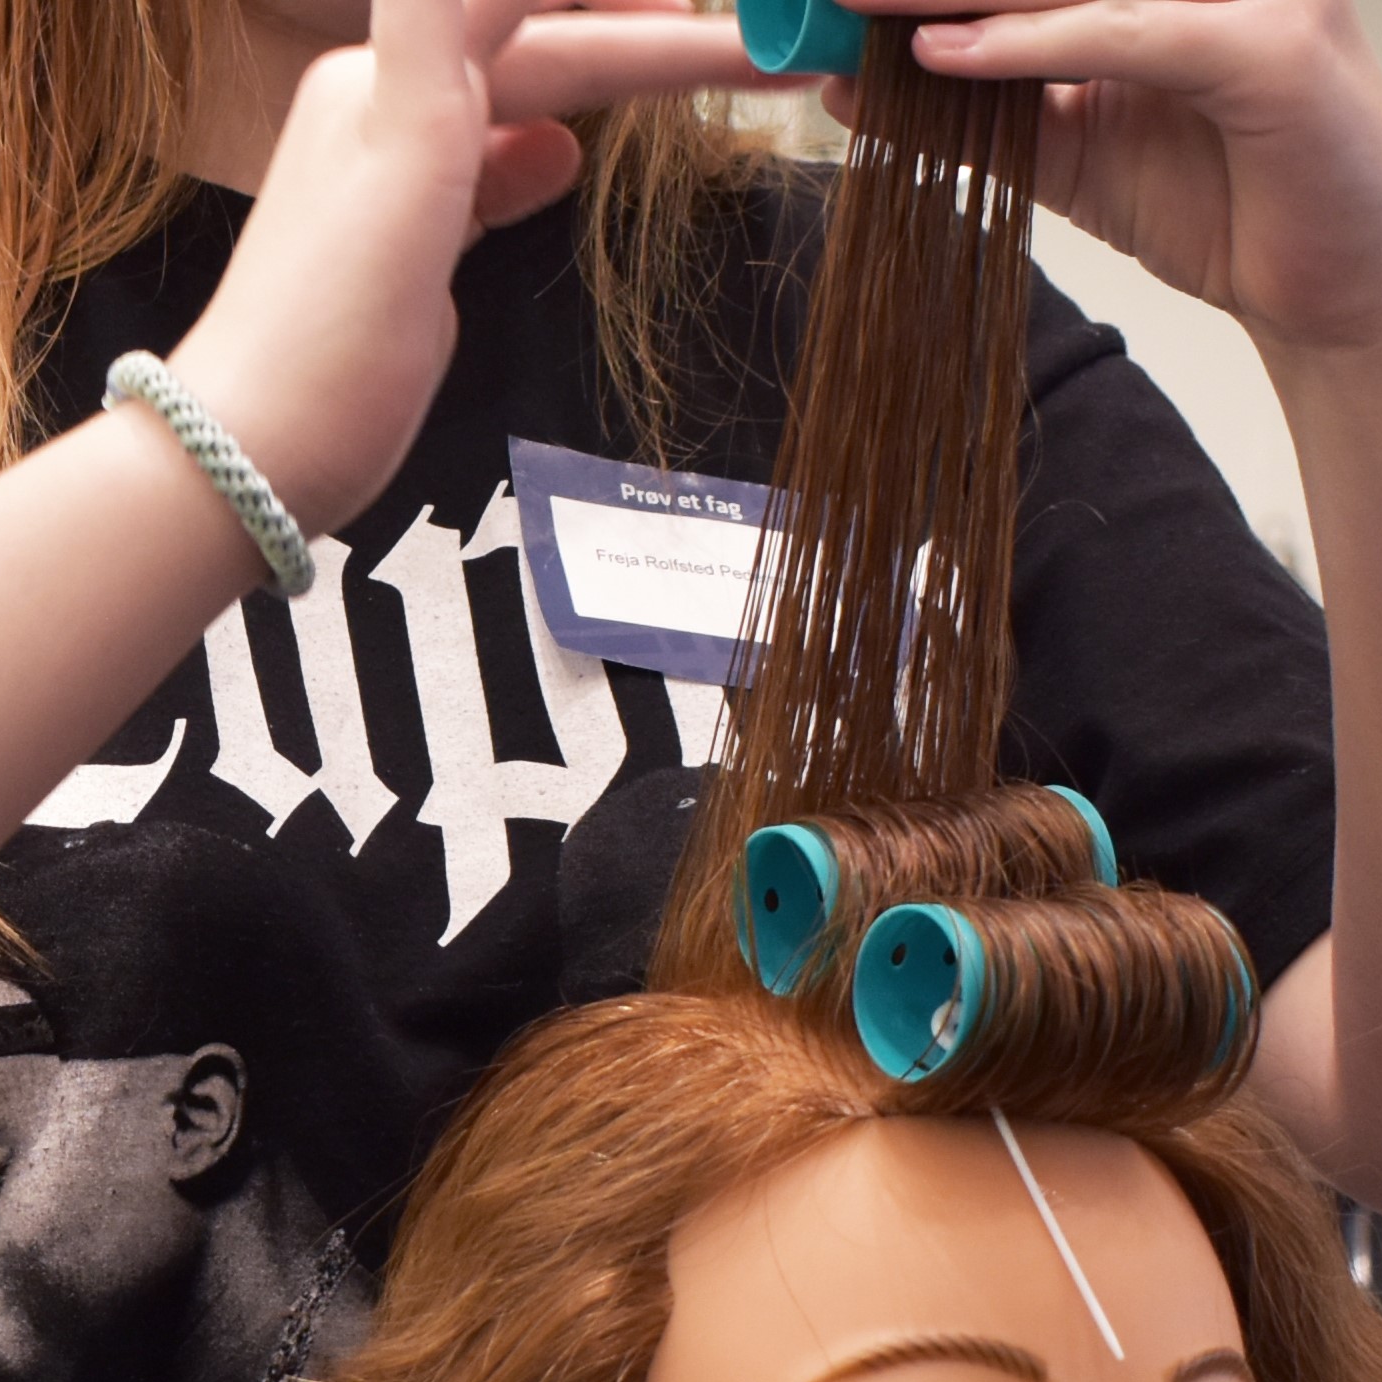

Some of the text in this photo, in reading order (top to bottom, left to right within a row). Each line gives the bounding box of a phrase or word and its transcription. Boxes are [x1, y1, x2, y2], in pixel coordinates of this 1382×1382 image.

[620, 483, 743, 520] Prøv et fag
[595, 549, 639, 567] Freja
[645, 557, 715, 576] Rolfsted
